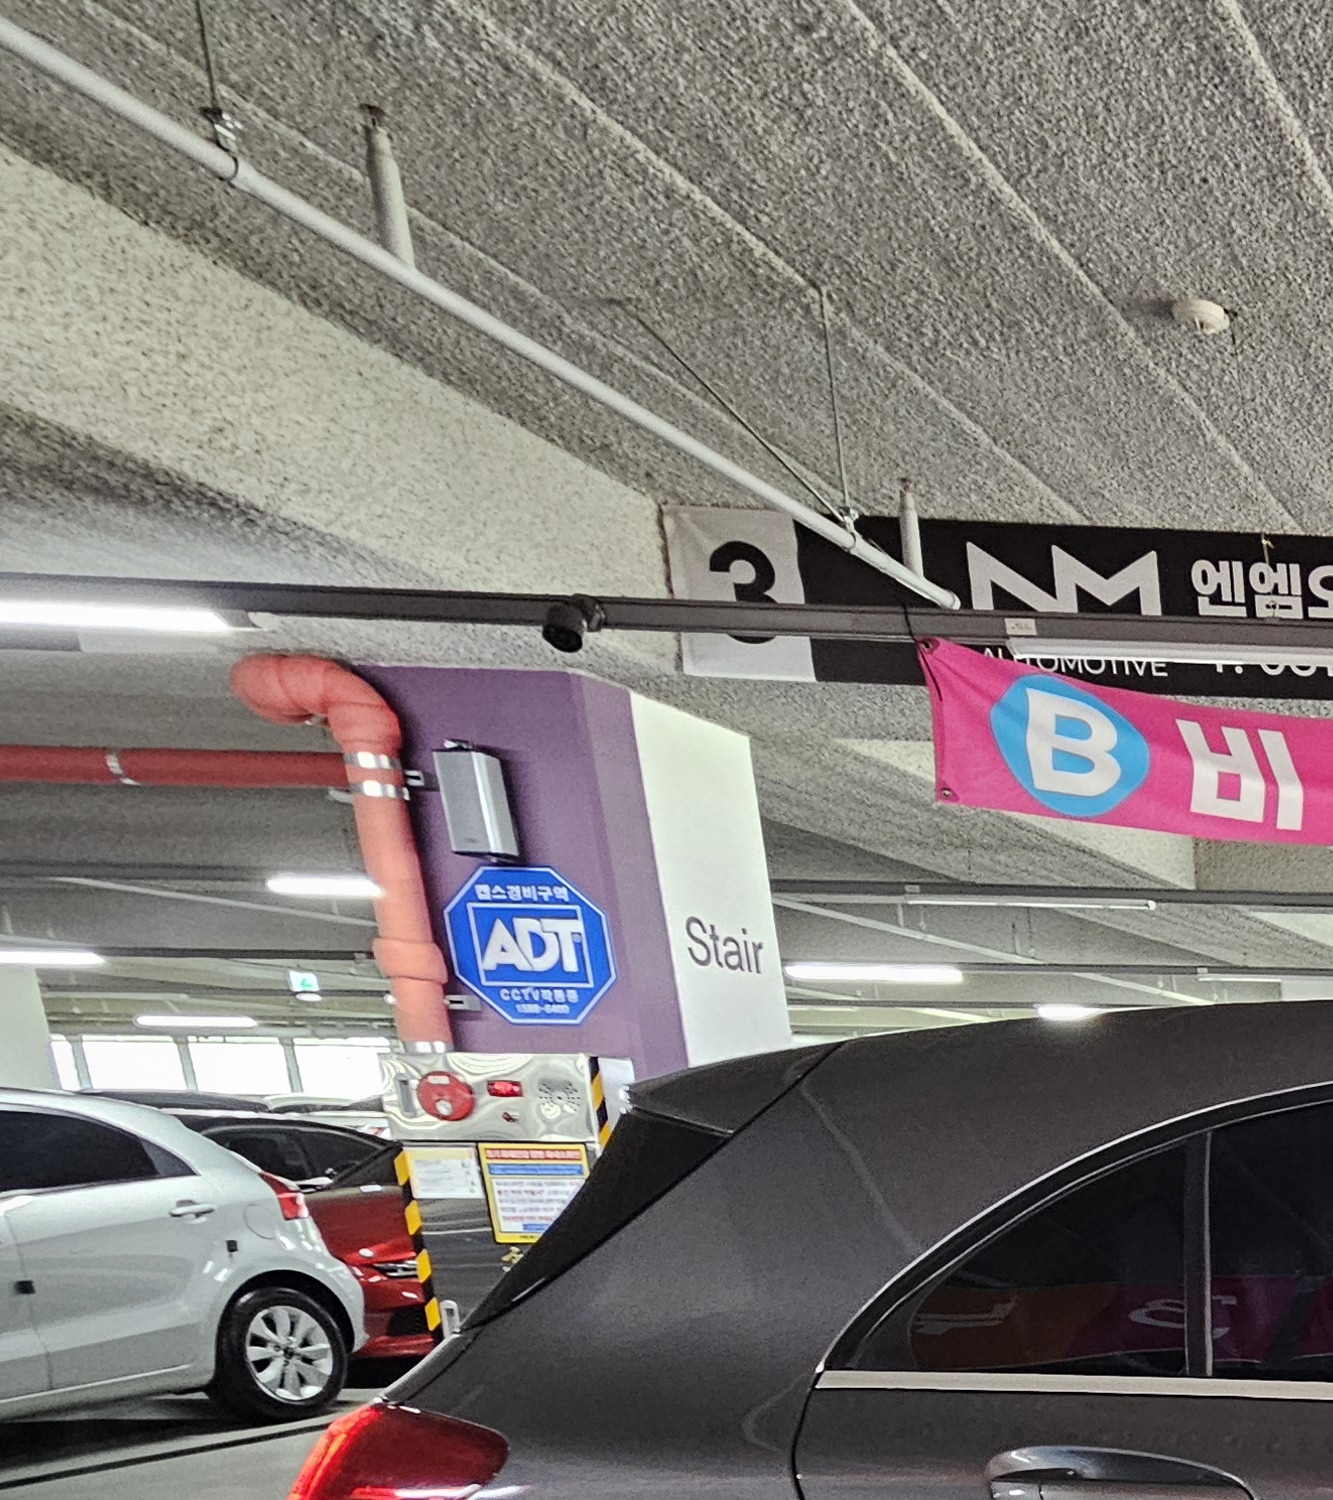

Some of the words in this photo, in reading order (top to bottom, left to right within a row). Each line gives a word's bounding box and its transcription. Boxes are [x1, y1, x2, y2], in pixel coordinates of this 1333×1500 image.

[1024, 687, 1121, 797] B
[482, 917, 583, 973] ADT
[685, 916, 765, 975] Stair
